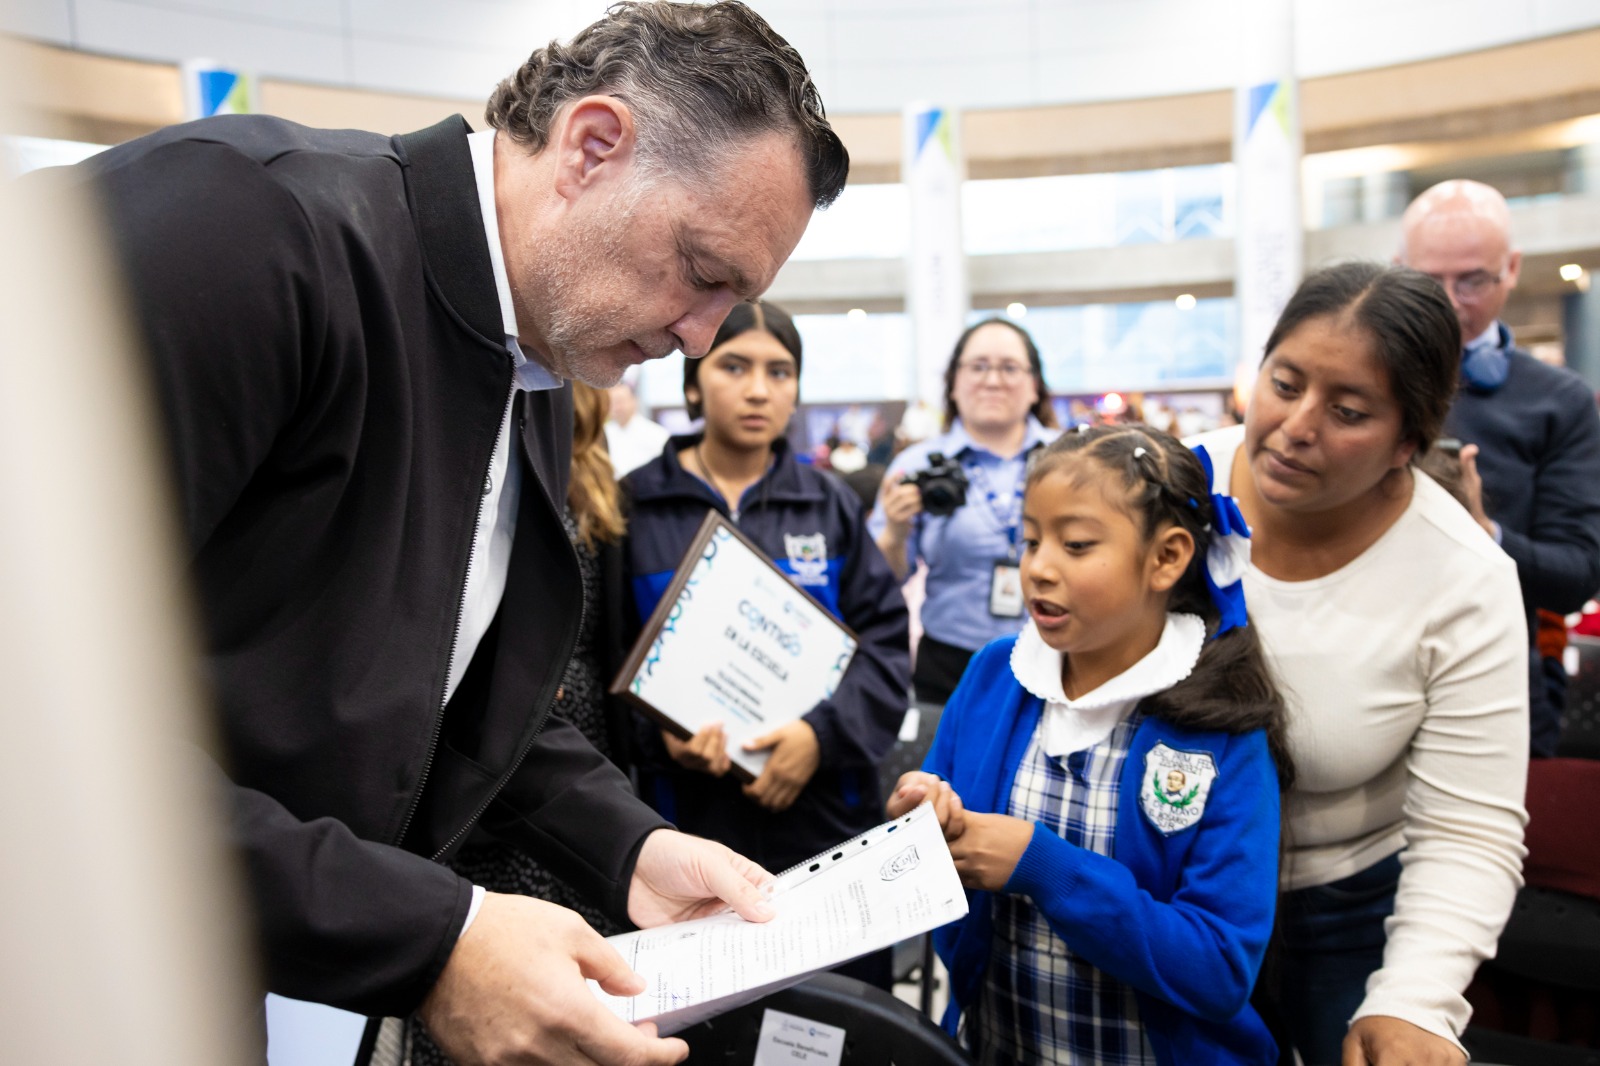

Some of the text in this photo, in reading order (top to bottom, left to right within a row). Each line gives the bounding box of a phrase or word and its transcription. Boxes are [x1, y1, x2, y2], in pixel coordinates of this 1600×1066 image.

[724, 626, 738, 642] EN
[738, 637, 751, 652] LA
[751, 646, 788, 681] ESCUELA
[738, 600, 801, 657] CONTIGO
